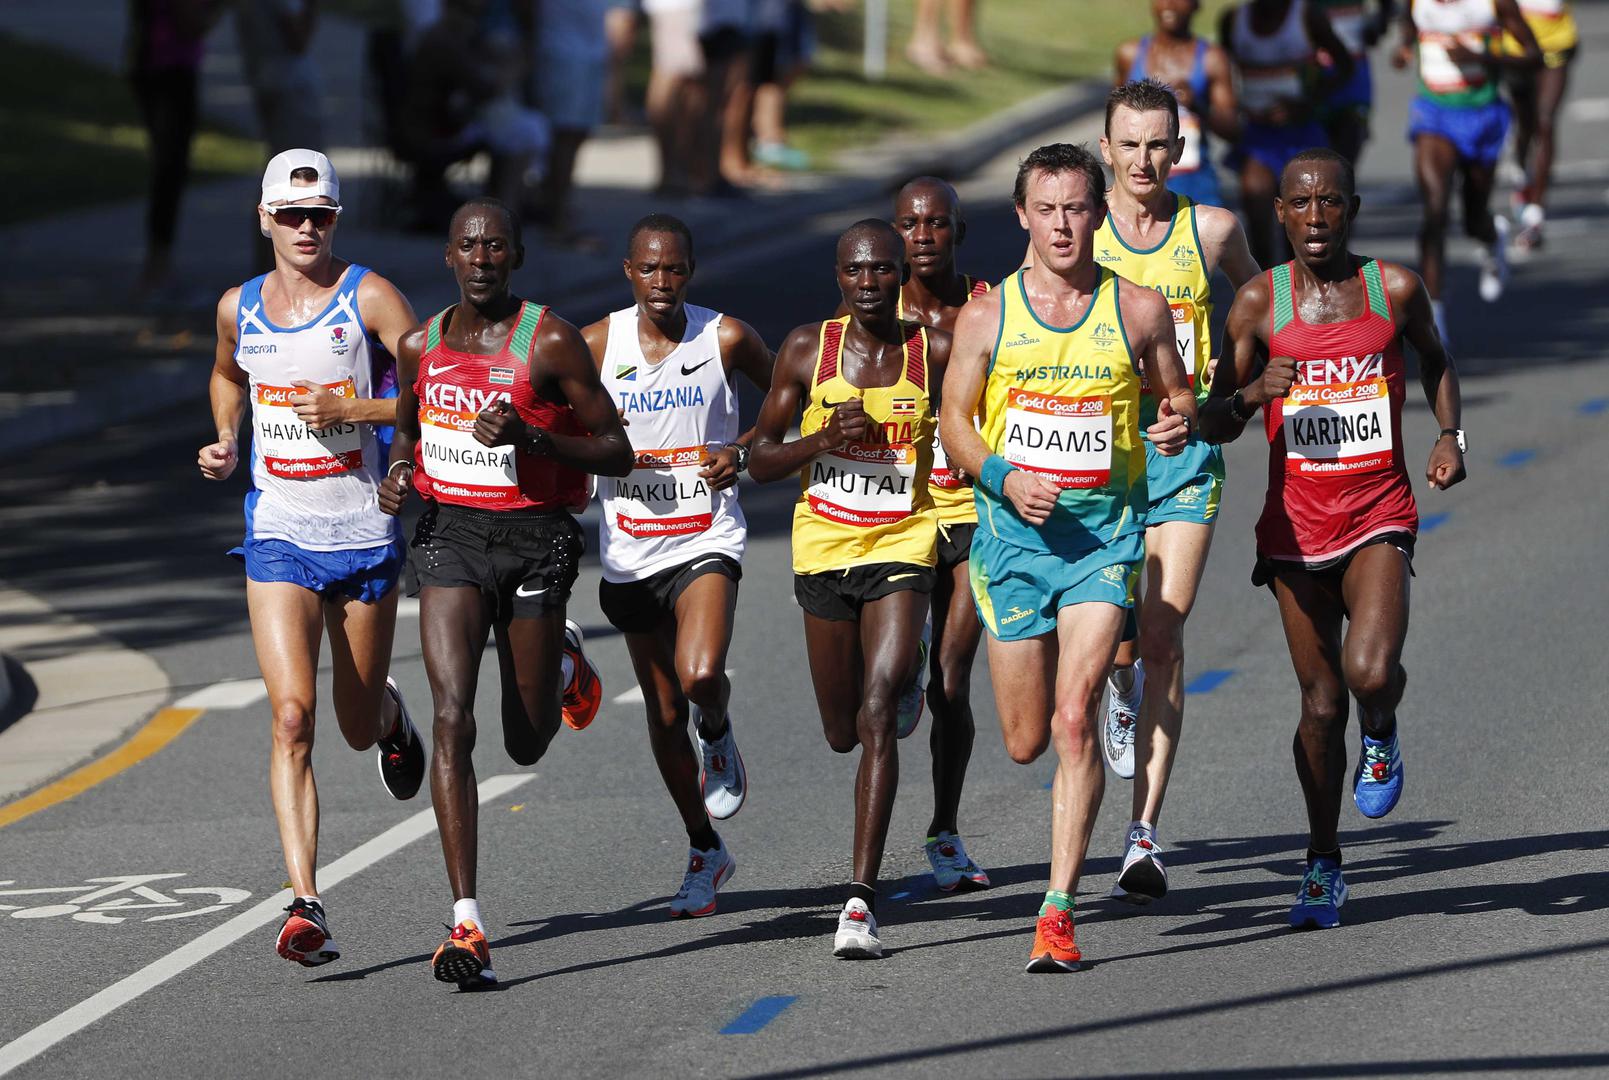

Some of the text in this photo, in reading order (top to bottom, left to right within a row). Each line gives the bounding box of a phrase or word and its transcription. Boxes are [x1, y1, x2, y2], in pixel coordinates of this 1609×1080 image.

[242, 344, 277, 355] macron
[1006, 338, 1040, 348] DIADORA
[1016, 365, 1112, 381] AUSTRALIA
[263, 390, 286, 402] Gold
[619, 386, 704, 413] TANZANIA
[1292, 389, 1318, 402] Gold
[1321, 387, 1353, 400] Coast
[1355, 383, 1378, 397] 2018
[1016, 394, 1103, 412] Gold Coast 2018
[426, 409, 477, 427] Gold Coas
[1292, 411, 1382, 446] KARINGA
[1008, 424, 1107, 453] ADAMS
[424, 441, 512, 468] MUNGARA
[642, 453, 675, 464] Coast
[676, 450, 700, 463] 2018
[849, 445, 883, 458] Coast
[883, 449, 907, 459] 2018
[281, 462, 314, 473] Griffith
[1312, 458, 1381, 472] Griffith UNIVERSITY
[813, 462, 909, 496] MUTAI
[1059, 475, 1098, 484] UNIVERSITY
[440, 485, 470, 497] Griffith
[616, 479, 707, 502] MAKULA
[813, 488, 829, 499] 2229
[828, 506, 860, 523] Griffith
[631, 521, 701, 532] Griffith UNIVERSITY
[1001, 608, 1034, 625] DIADORA
